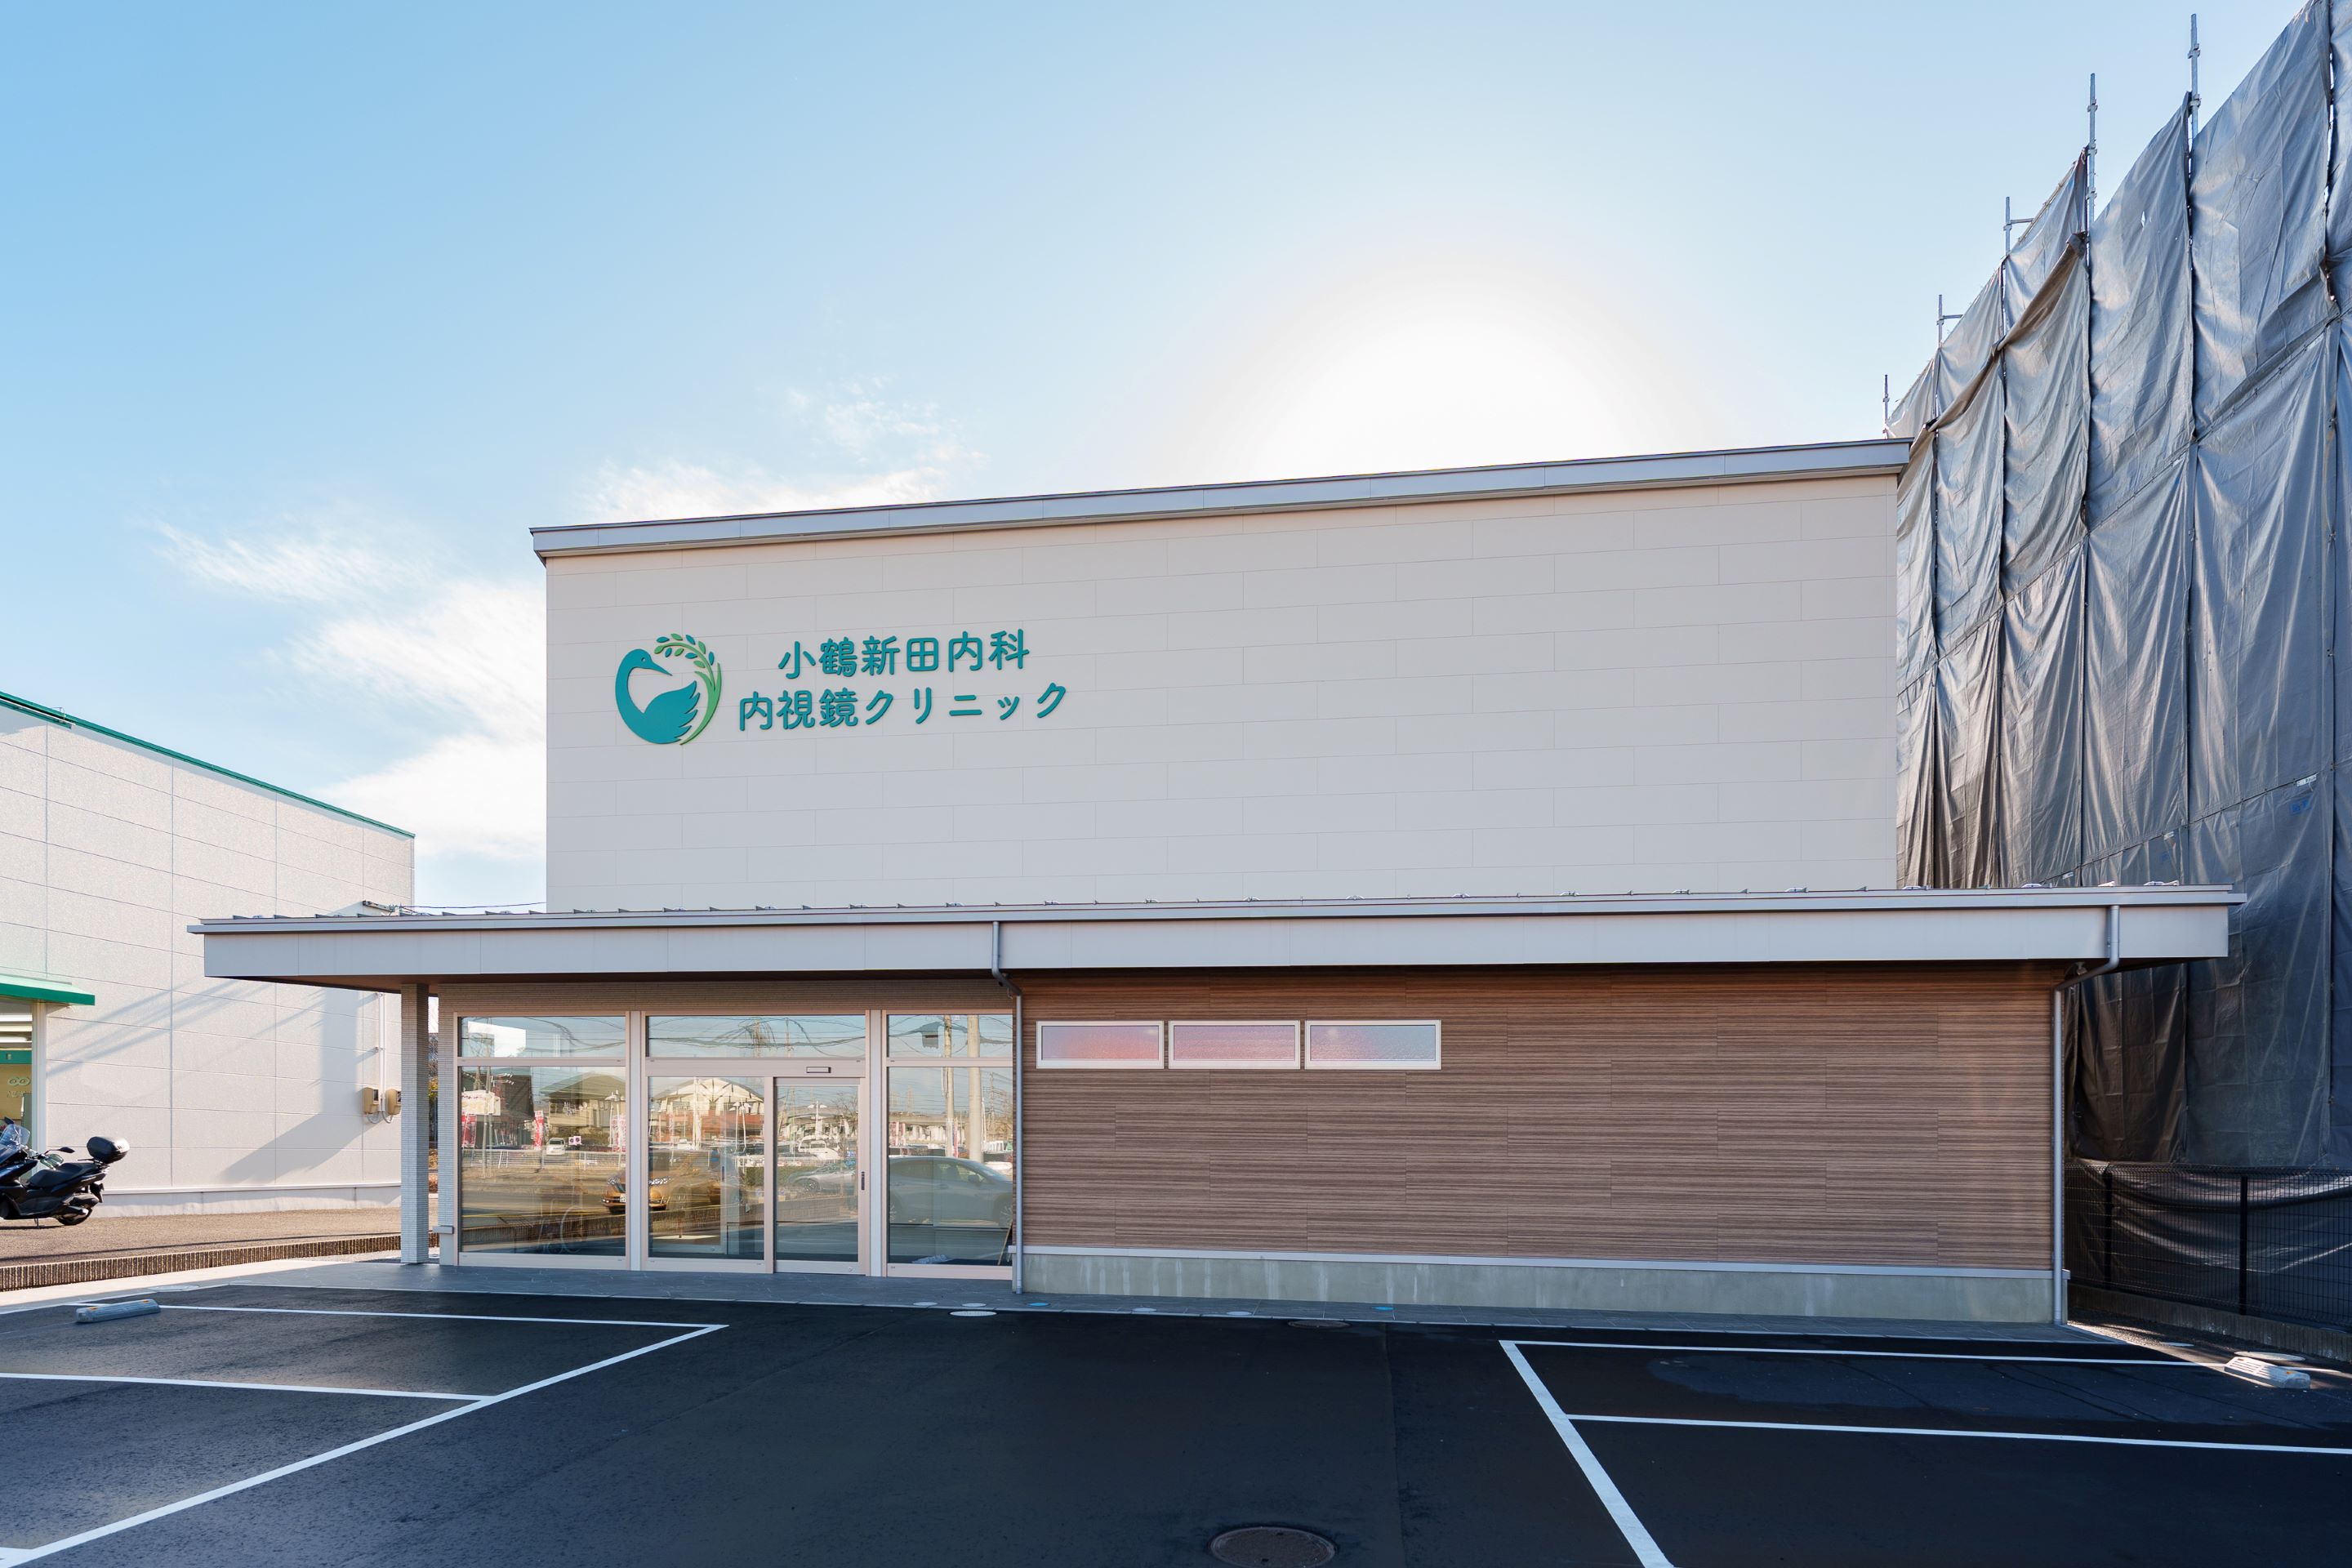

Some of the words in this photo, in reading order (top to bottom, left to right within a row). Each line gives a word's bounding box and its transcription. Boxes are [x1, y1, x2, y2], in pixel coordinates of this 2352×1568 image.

[777, 628, 1031, 679] 小鶴新田内科
[739, 682, 1067, 732] 内視鏡クリニック
